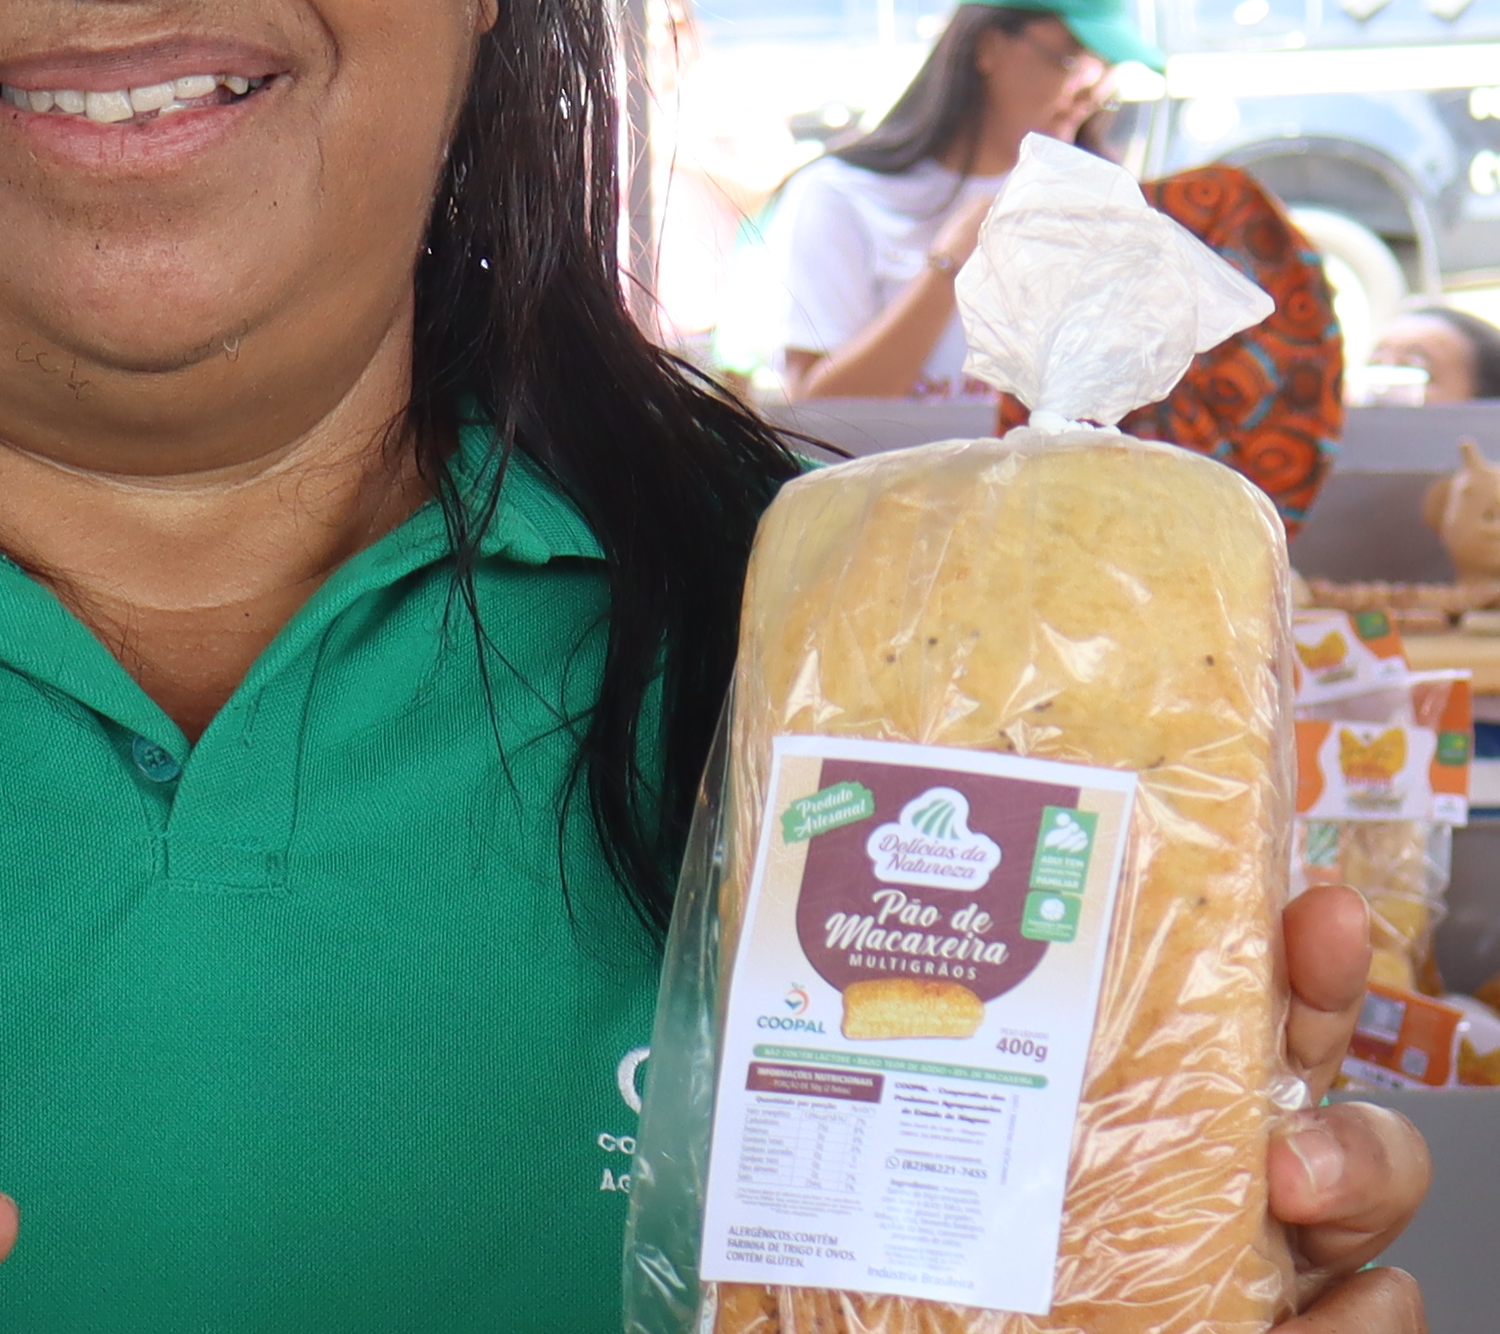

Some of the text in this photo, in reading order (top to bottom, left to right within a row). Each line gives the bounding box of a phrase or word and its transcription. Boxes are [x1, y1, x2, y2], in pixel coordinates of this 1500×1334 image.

[793, 798, 867, 838] Artesanal
[796, 788, 854, 819] Produto
[879, 833, 988, 863] Delícias da
[886, 853, 977, 879] Natureza
[872, 889, 941, 927] Pão
[951, 903, 994, 934] de
[825, 912, 1010, 965] Macaxeira
[849, 953, 978, 980] MULTIGRÃOS
[757, 1016, 827, 1035] COOPAL
[996, 1037, 1048, 1063] 400g
